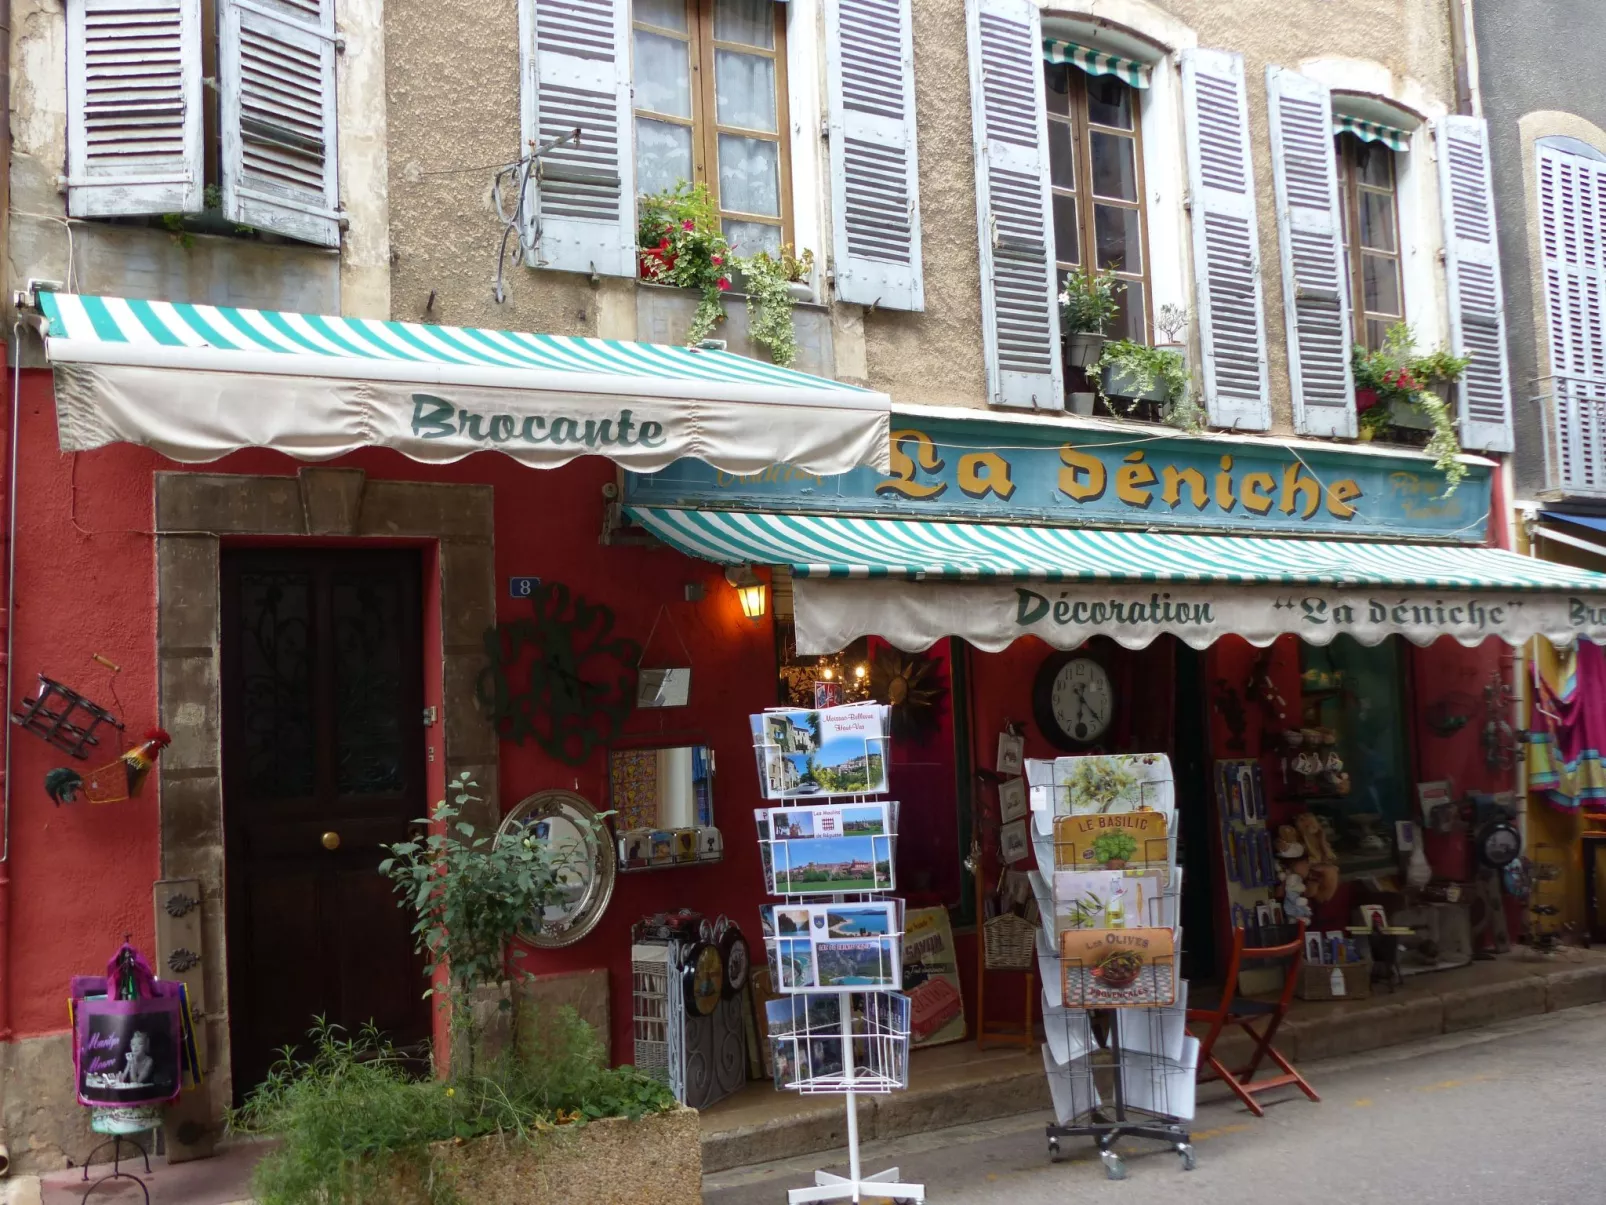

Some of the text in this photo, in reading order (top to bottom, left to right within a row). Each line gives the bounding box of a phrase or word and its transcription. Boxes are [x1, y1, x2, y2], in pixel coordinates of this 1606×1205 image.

[411, 394, 666, 448] Brocante
[875, 429, 1363, 521] La déniche
[520, 580, 531, 595] 8
[1014, 588, 1215, 625] Décoration
[1078, 816, 1149, 833] LE BASILIC
